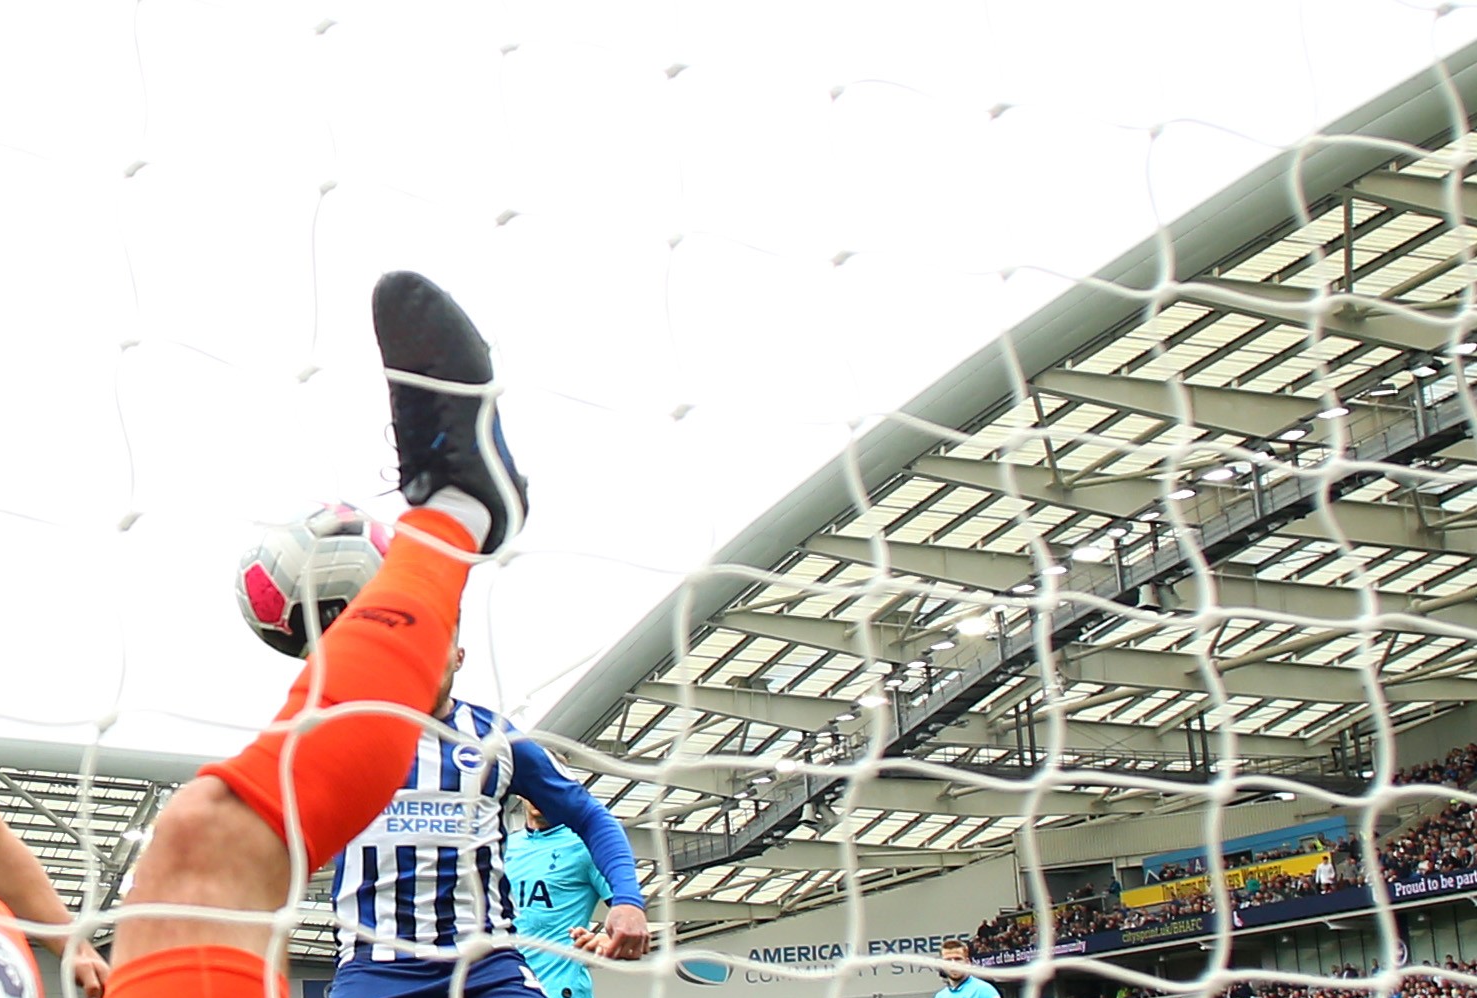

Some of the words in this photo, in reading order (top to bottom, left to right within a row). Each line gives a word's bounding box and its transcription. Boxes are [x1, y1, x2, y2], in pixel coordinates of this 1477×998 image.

[519, 880, 553, 908] IA
[1393, 878, 1426, 897] Proud
[1427, 877, 1439, 891] to
[1440, 874, 1455, 889] be
[1456, 870, 1477, 889] part
[748, 943, 854, 964] AMERICA
